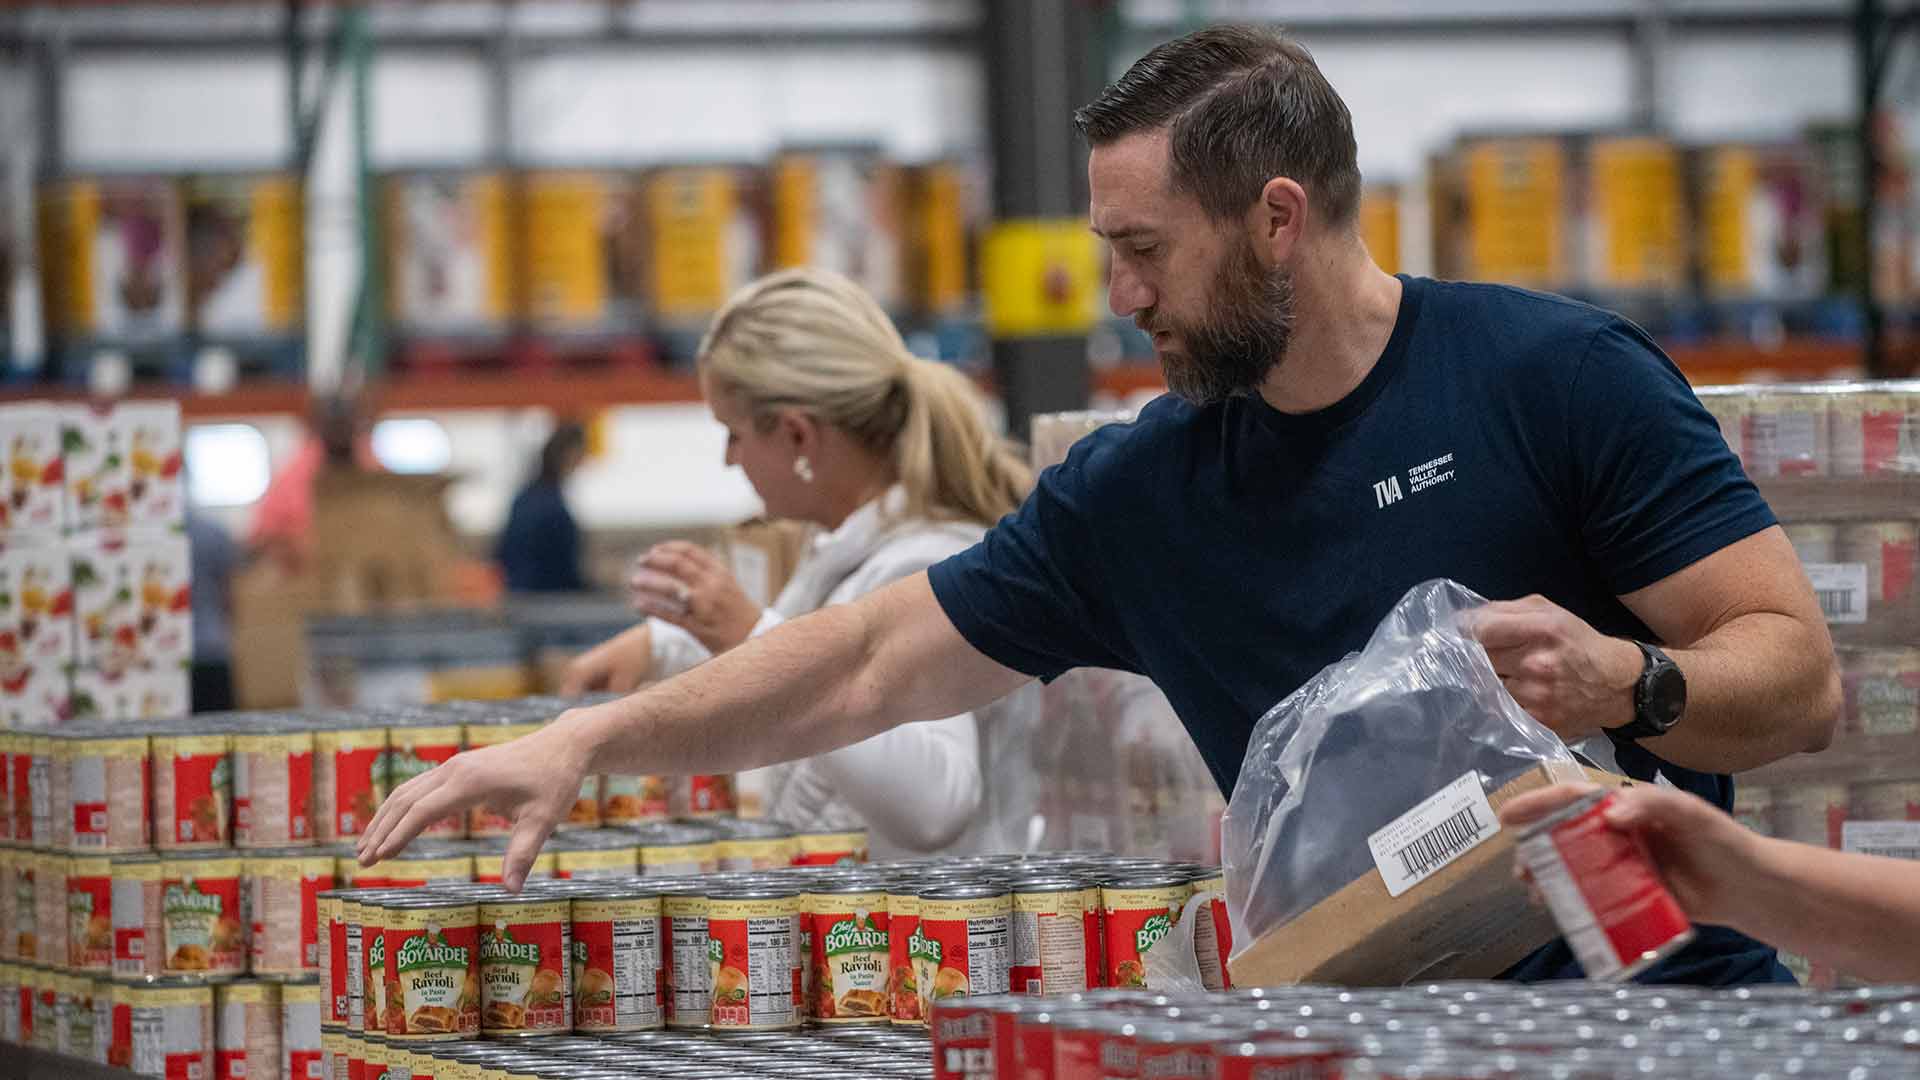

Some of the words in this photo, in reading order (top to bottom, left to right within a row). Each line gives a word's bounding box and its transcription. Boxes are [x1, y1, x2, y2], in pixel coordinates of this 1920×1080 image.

[1408, 453, 1454, 477] TENNESSEE
[1409, 467, 1438, 485] VALLEY
[1411, 470, 1455, 493] AUTHORITY
[1373, 475, 1403, 509] TVA
[832, 920, 854, 935] Chef
[403, 935, 426, 951] Chef
[825, 931, 889, 953] BOYARDE
[397, 945, 469, 969] BOYARDEE
[480, 943, 539, 962] OYARDEE
[853, 953, 871, 962] Beef
[424, 970, 443, 979] Beef
[841, 959, 883, 974] Ravioli
[412, 976, 455, 991] Ravioli
[428, 987, 446, 996] Pasta
